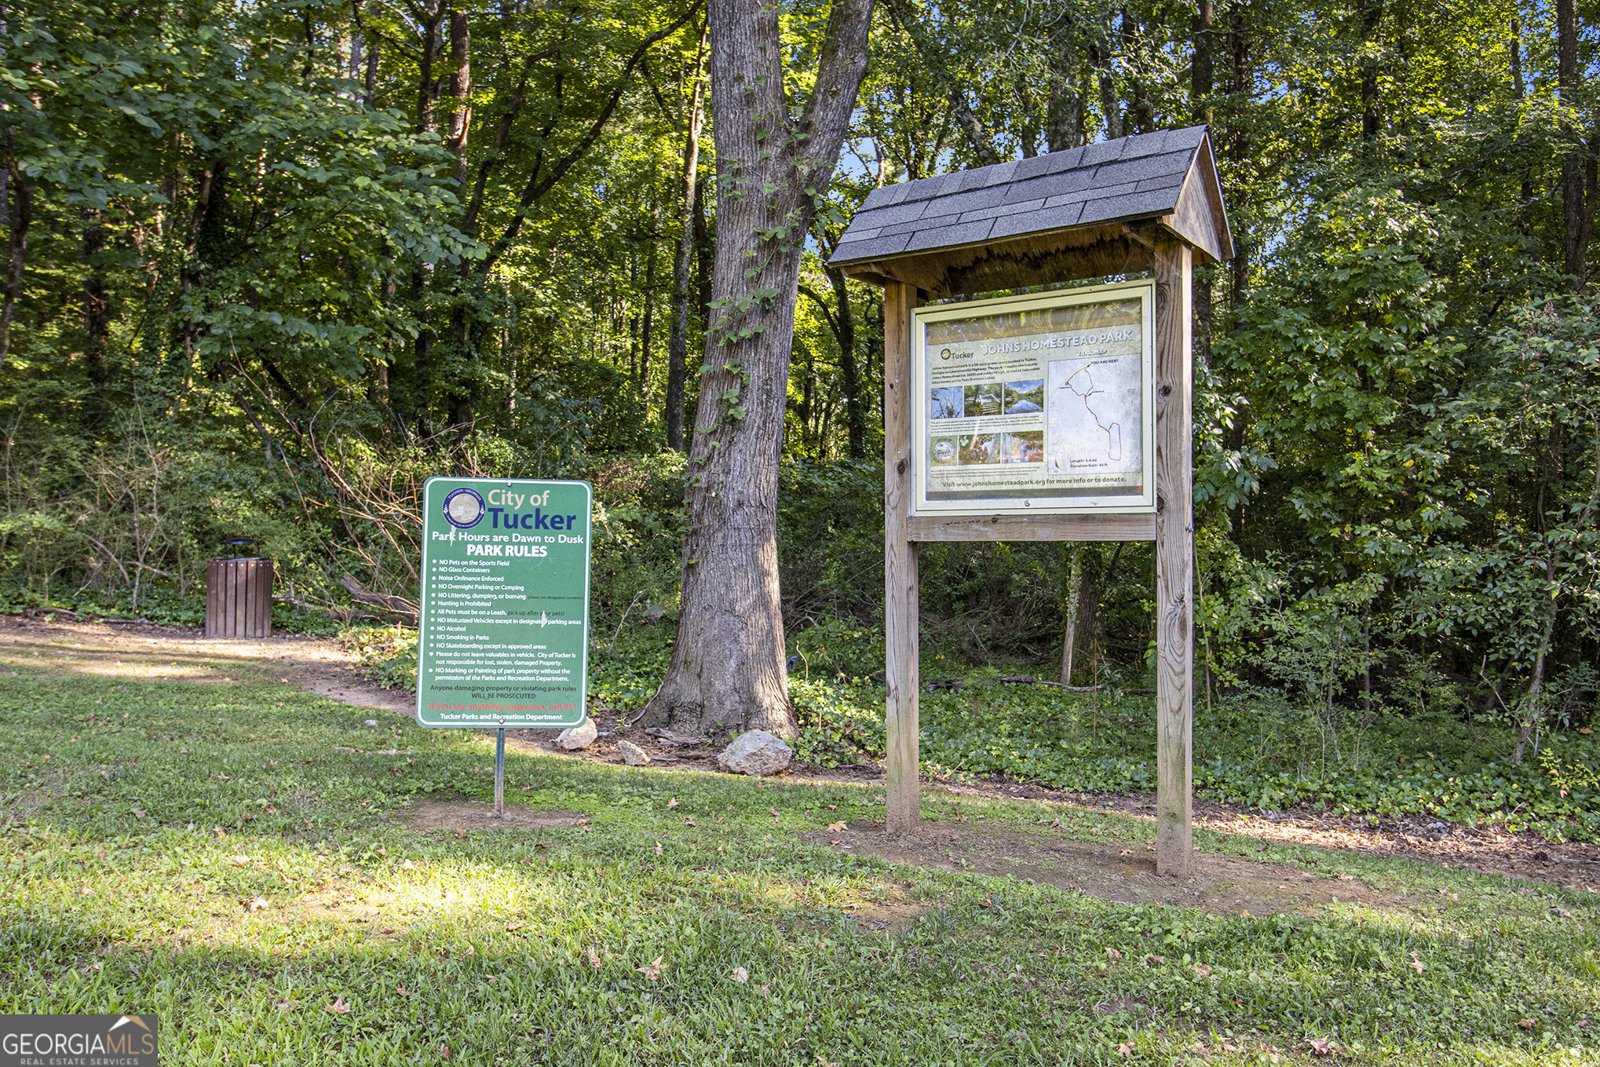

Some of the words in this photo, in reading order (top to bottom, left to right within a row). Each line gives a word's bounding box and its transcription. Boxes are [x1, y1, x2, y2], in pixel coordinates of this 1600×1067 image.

[983, 343, 1021, 355] JOHNS
[1023, 335, 1098, 350] HOMESTEAD
[1100, 331, 1133, 343] PARK
[951, 352, 974, 360] Tucker
[956, 479, 1045, 488] www.johnshomesteadpark.org
[488, 489, 526, 510] City
[530, 490, 550, 506] of
[488, 508, 577, 530] Tucker
[432, 531, 456, 542] Park
[459, 532, 490, 542] Hours
[493, 534, 509, 542] are
[512, 533, 541, 543] Dawn
[544, 535, 555, 543] to
[558, 534, 584, 544] Dusk
[467, 544, 503, 556] PARK
[505, 545, 548, 557] RULES
[468, 704, 502, 712] anything
